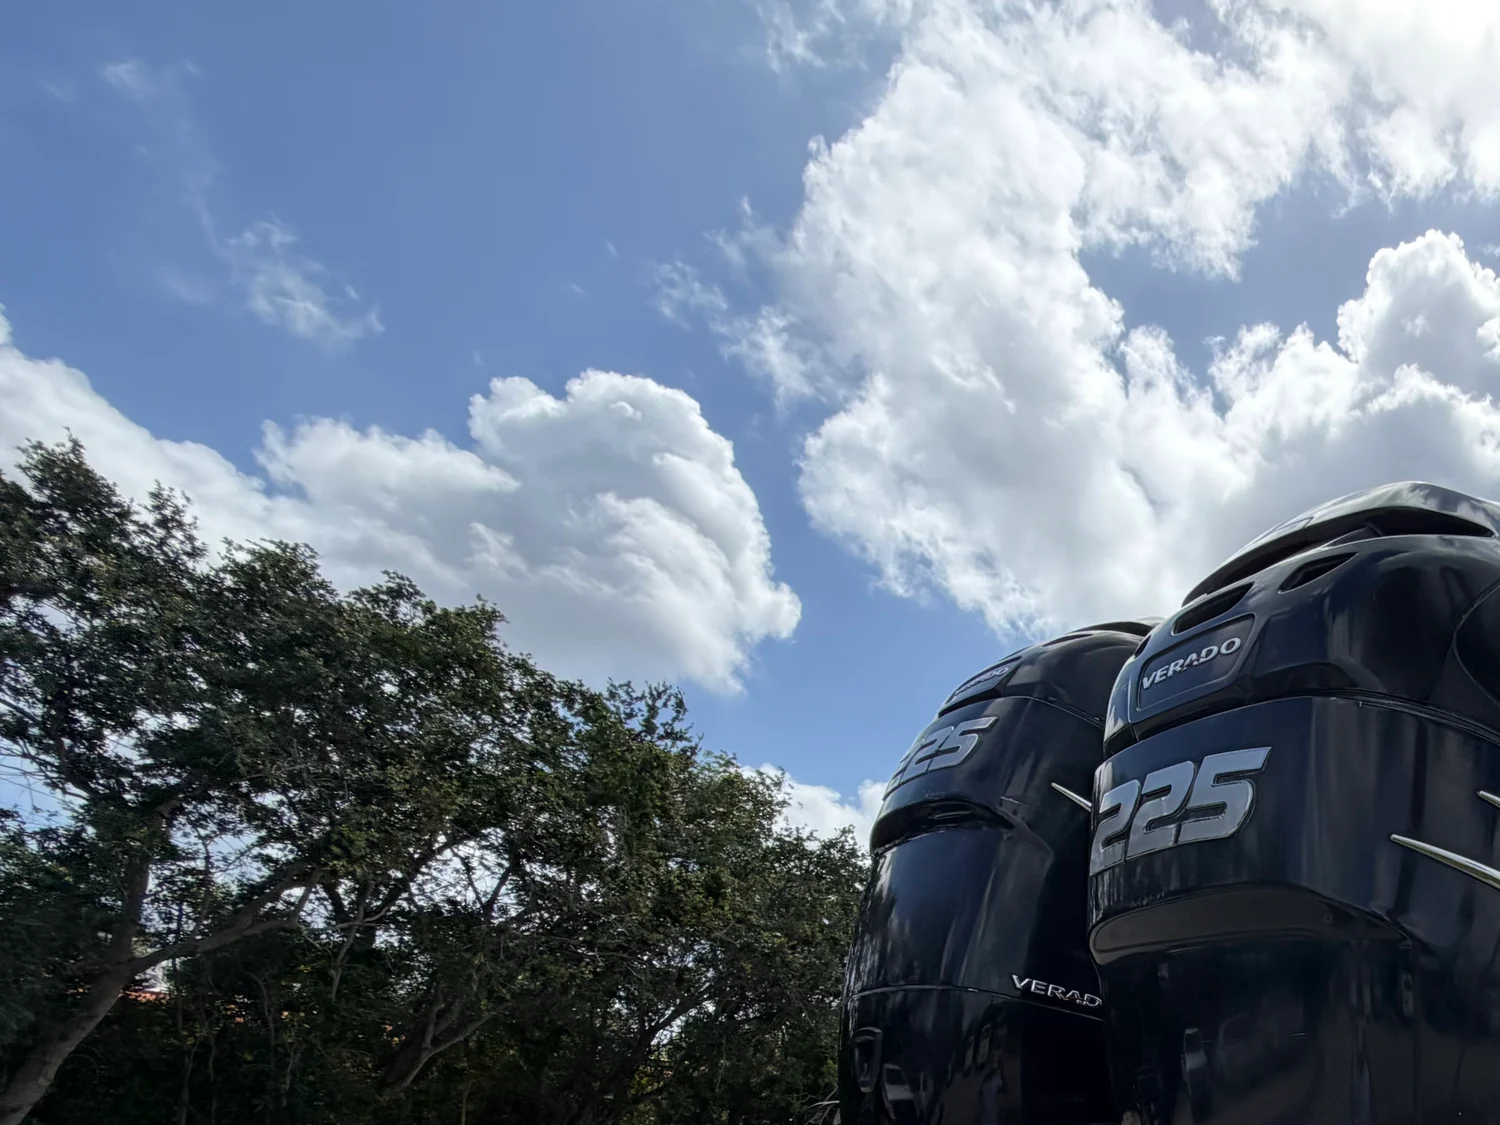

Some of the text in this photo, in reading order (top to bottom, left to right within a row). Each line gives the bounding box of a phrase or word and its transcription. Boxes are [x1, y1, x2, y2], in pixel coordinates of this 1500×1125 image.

[1142, 637, 1242, 690] VERADO
[1089, 746, 1272, 877] 225
[1012, 974, 1102, 1007] VERAD
